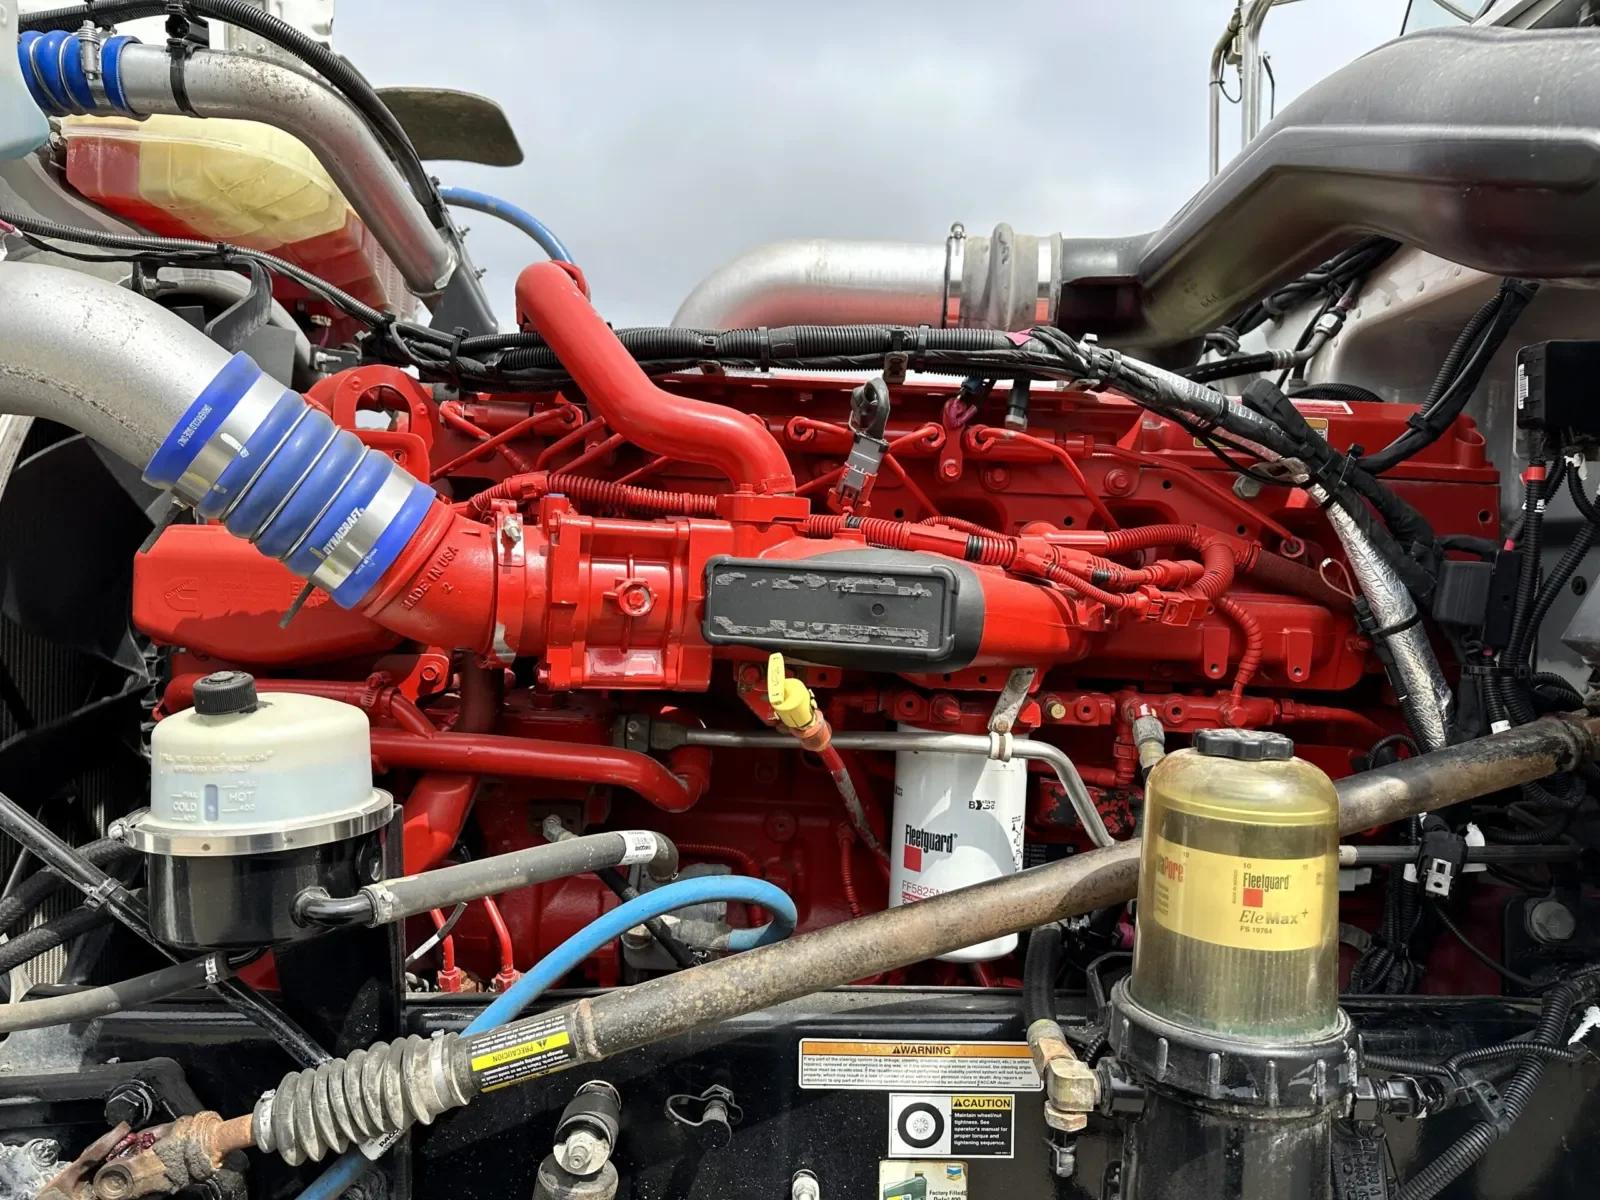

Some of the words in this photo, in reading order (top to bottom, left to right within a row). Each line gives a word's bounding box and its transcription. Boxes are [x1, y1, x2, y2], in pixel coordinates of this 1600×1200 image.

[322, 507, 362, 556] DYNACRAFT
[400, 579, 432, 611] MADE
[427, 566, 445, 583] IN
[438, 546, 460, 567] USA
[229, 790, 256, 802] HOT
[172, 800, 198, 812] COLD
[1243, 872, 1290, 893] Fleetguard
[901, 1045, 951, 1055] WARNING
[963, 1099, 1011, 1108] CAUTION
